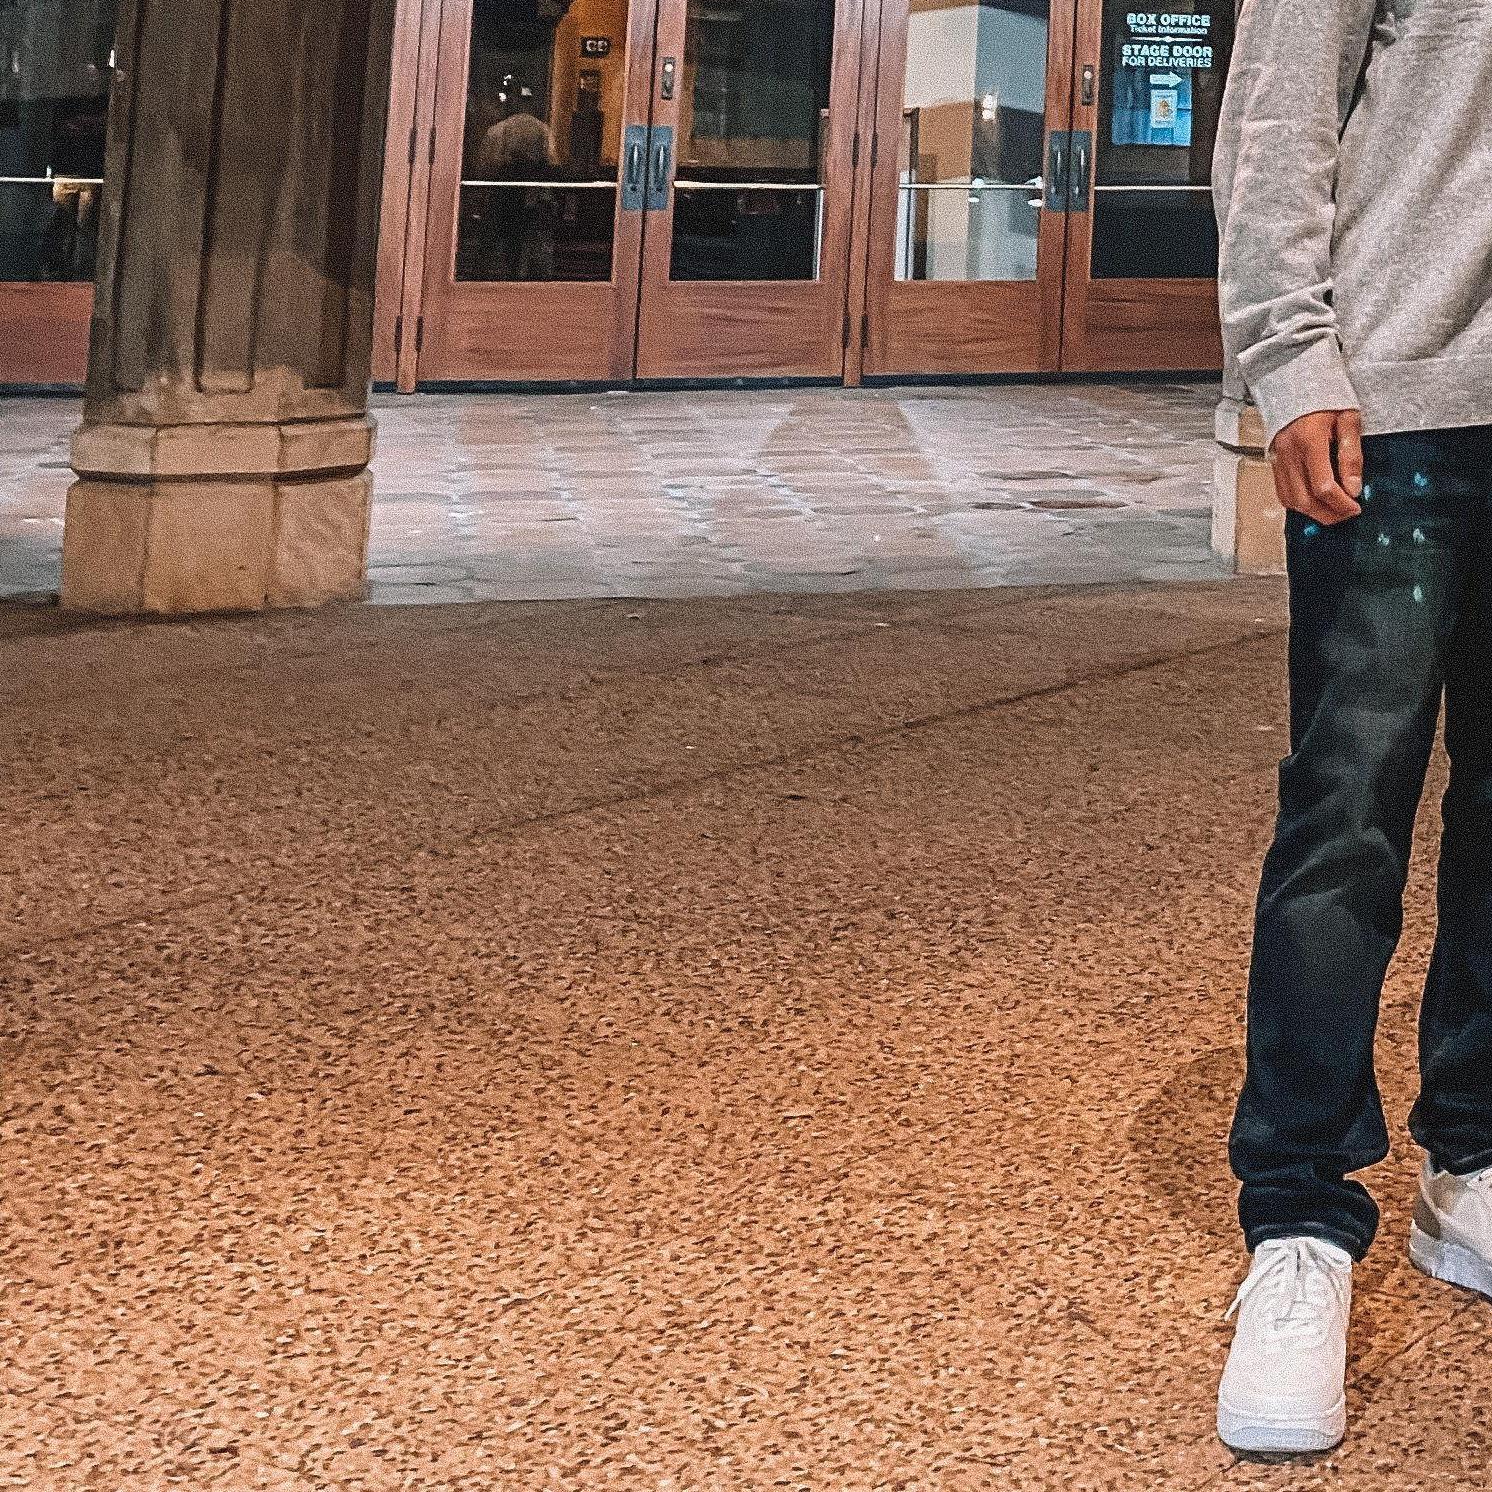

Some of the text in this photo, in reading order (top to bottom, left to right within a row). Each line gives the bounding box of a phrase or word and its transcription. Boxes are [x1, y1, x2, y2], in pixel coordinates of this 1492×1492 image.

[1126, 12, 1211, 27] BOX OFFICE
[1130, 24, 1157, 34] Ticket
[1121, 44, 1213, 58] STAGE DOOR
[1121, 56, 1213, 68] FOR DELIVERIES
